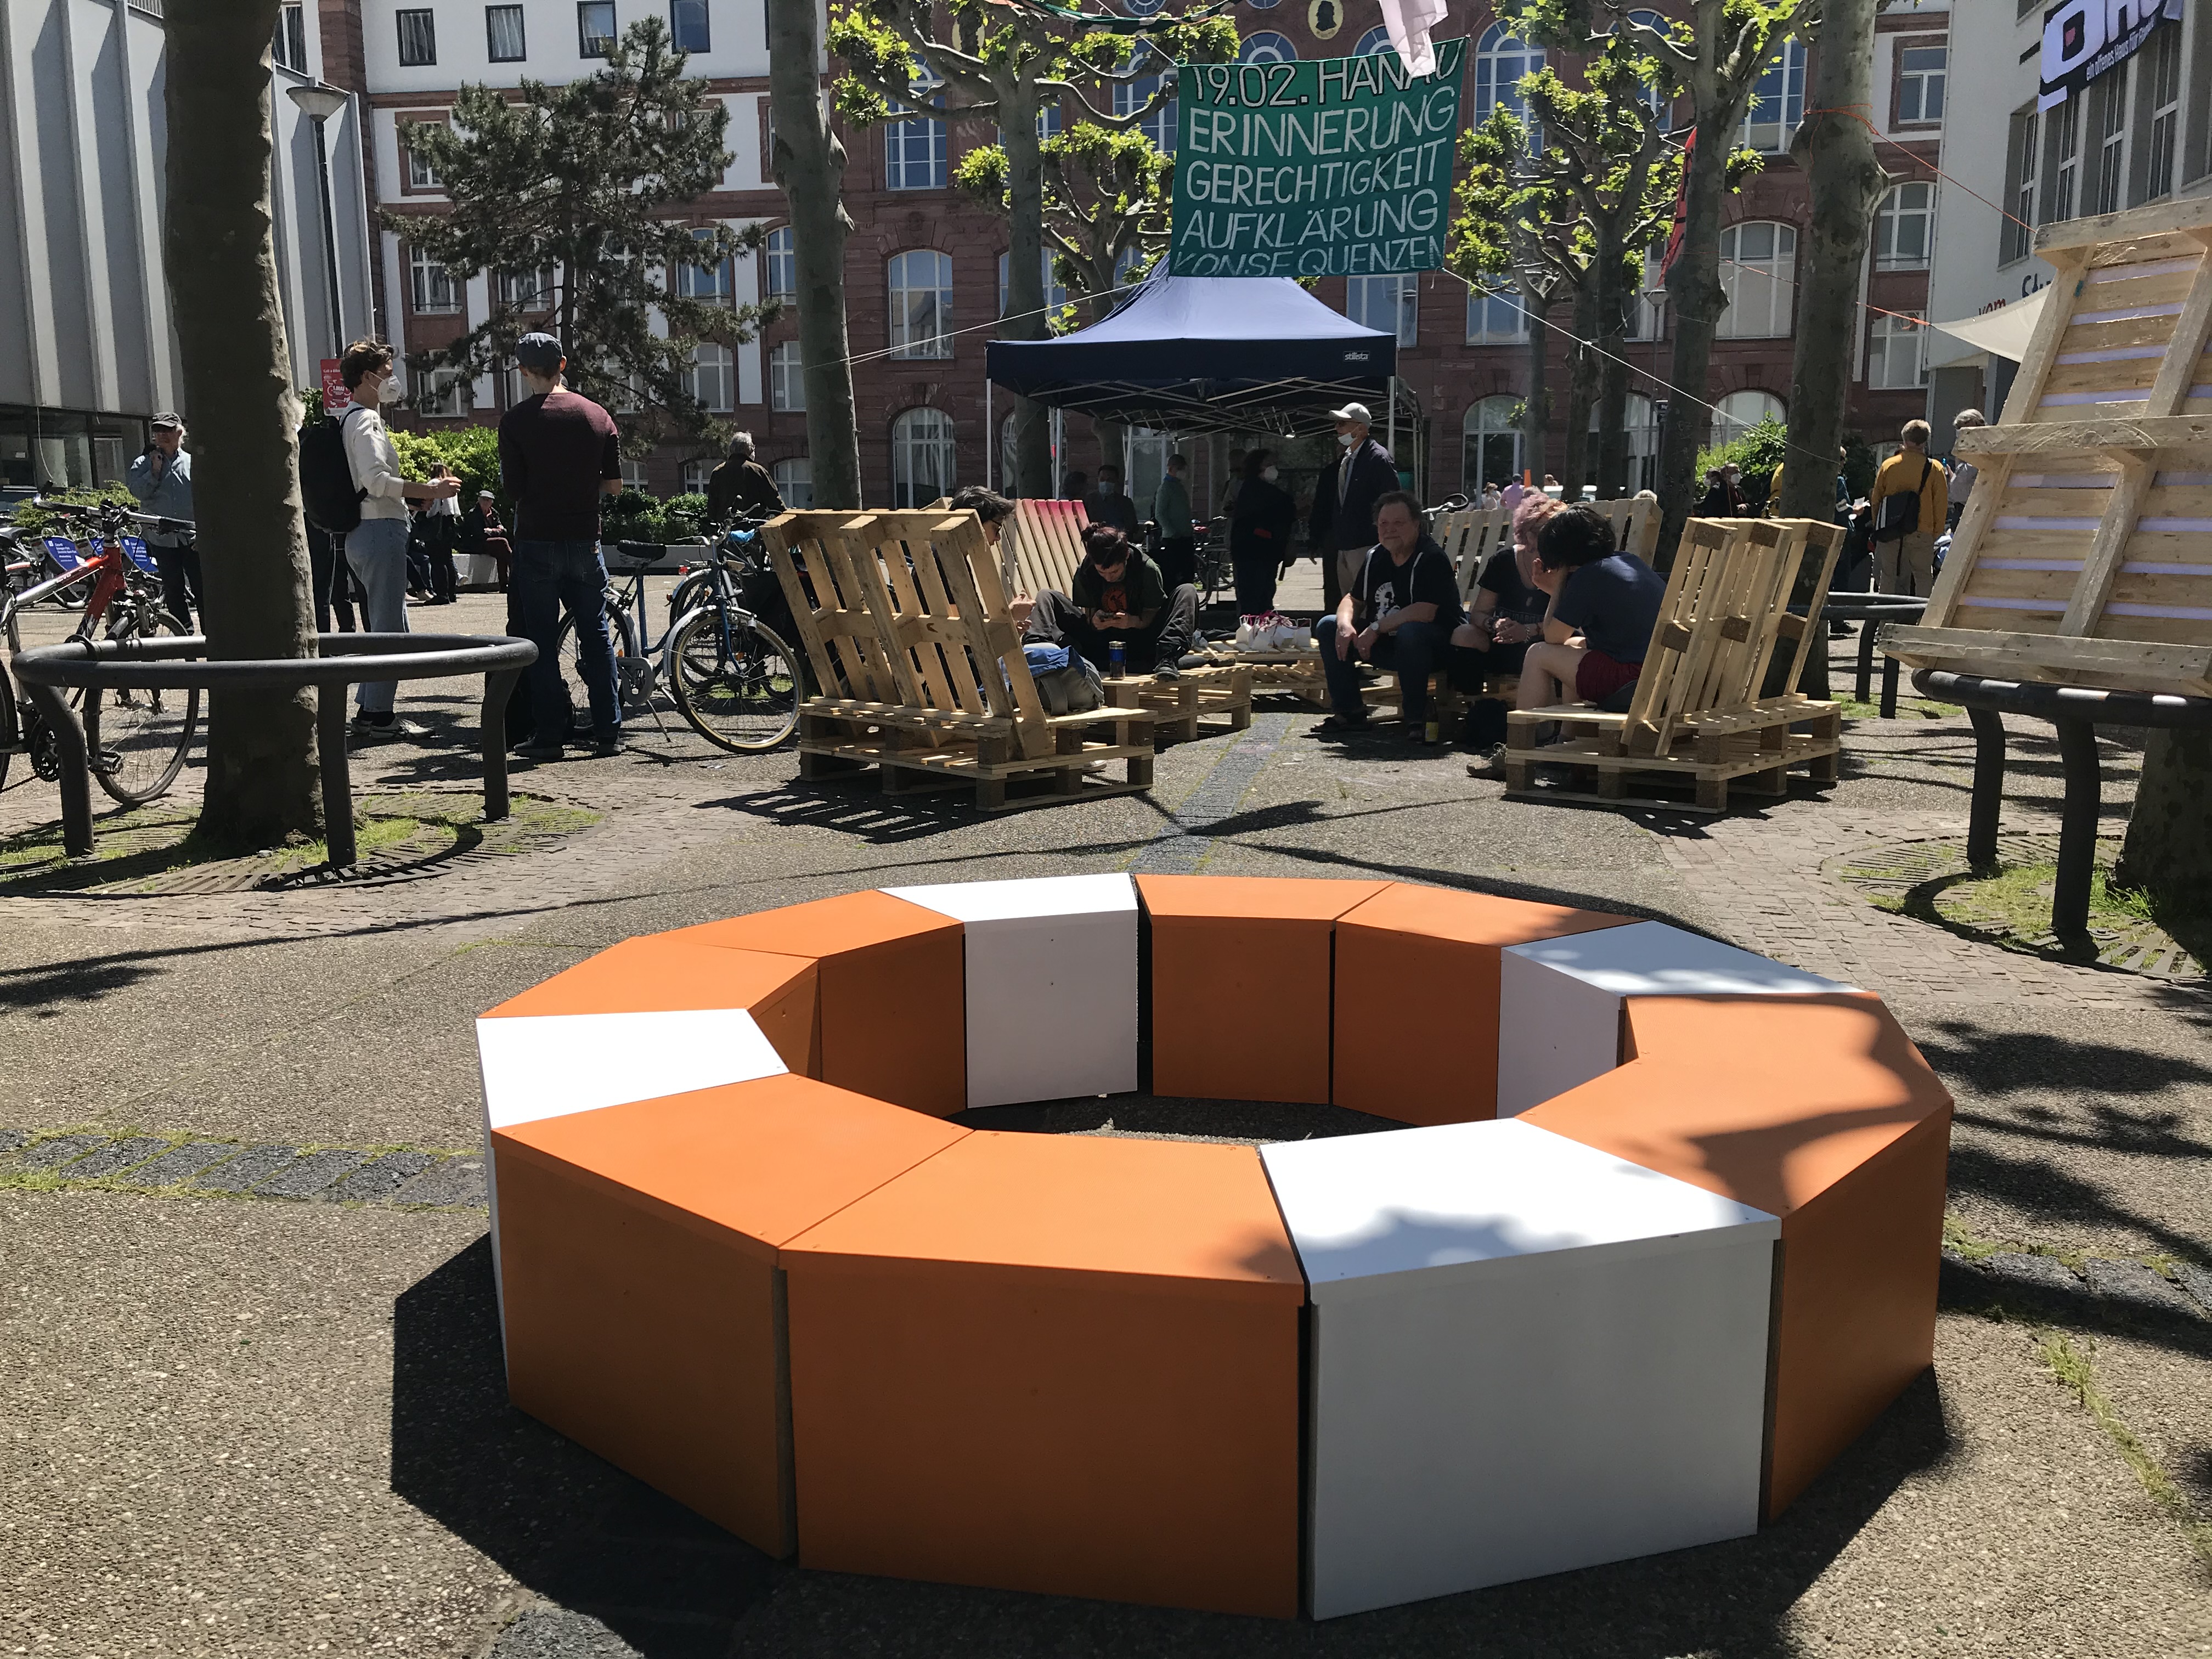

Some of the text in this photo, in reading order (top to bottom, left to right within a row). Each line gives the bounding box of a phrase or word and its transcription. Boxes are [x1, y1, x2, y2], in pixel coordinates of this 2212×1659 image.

[1192, 40, 1465, 108] 19.02. HANU
[1189, 86, 1455, 157] ERINNERUNG
[1186, 137, 1447, 206] GERECHTIGKEIT
[1180, 188, 1438, 249] AUFKLÄRUNG
